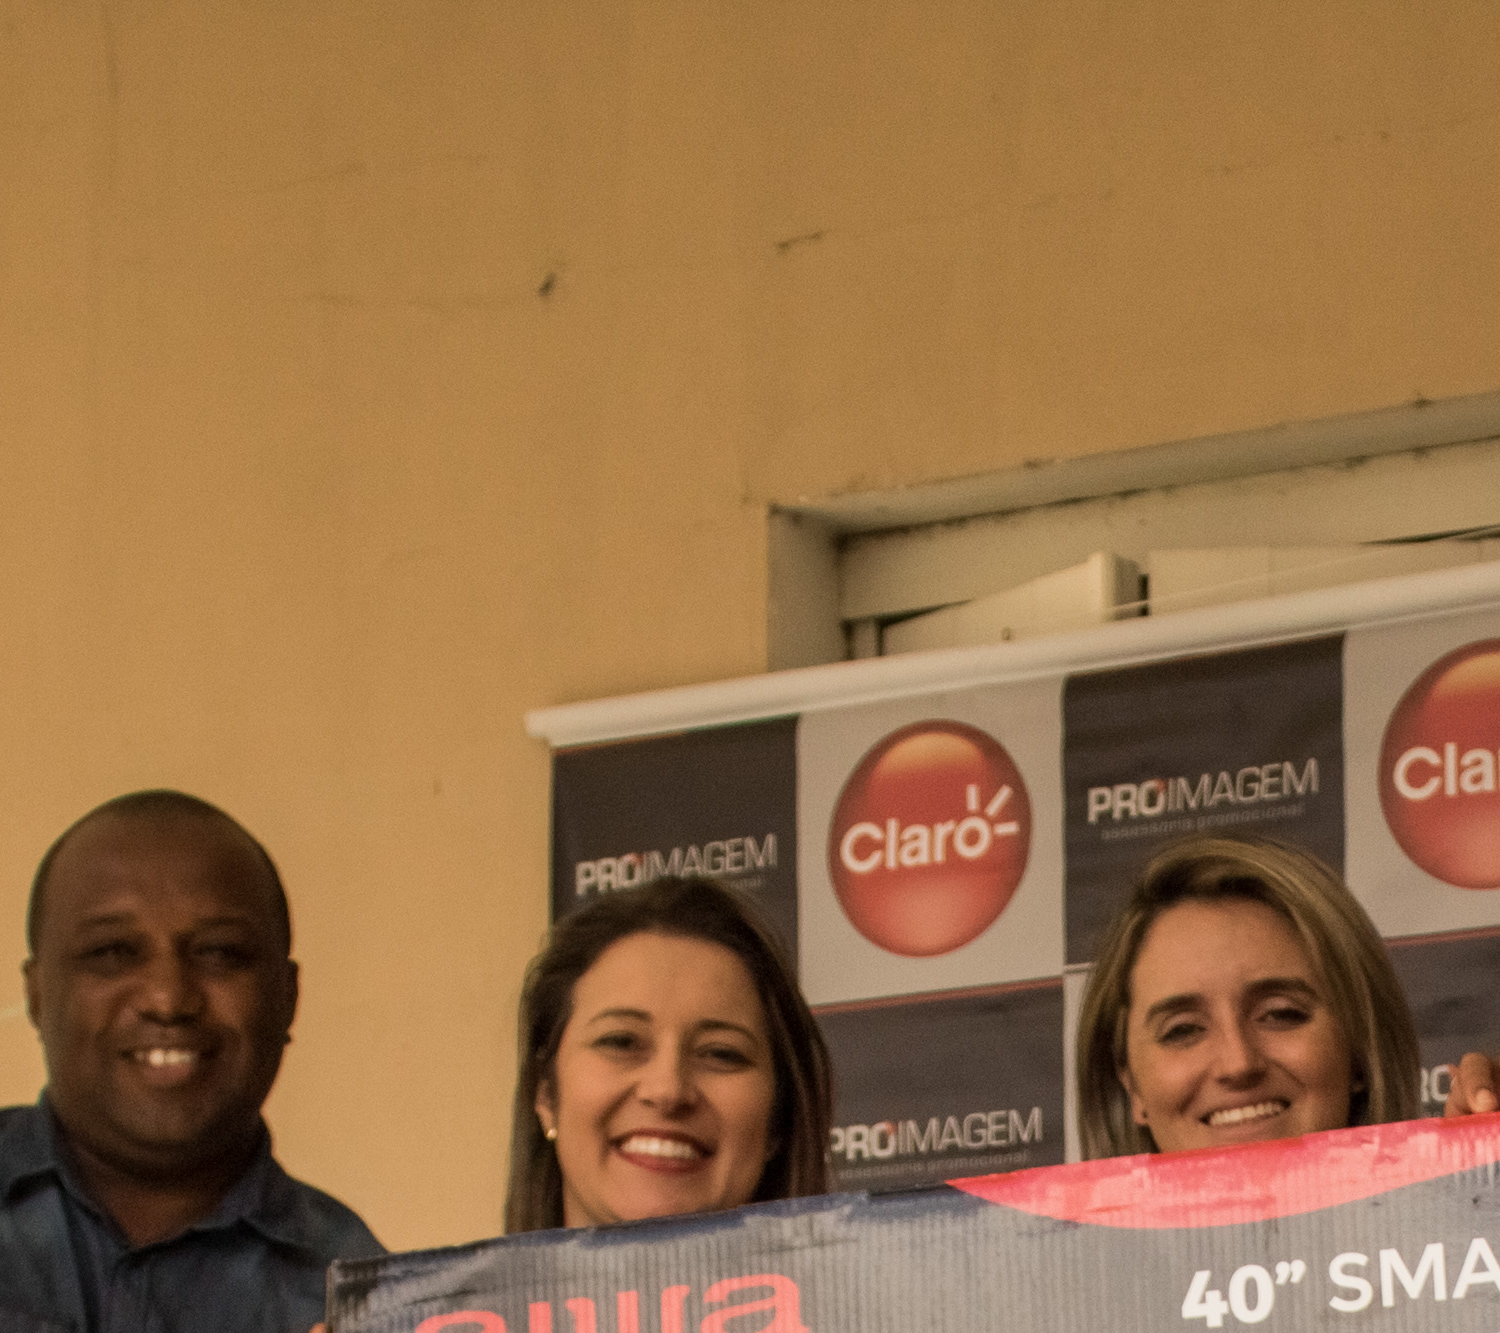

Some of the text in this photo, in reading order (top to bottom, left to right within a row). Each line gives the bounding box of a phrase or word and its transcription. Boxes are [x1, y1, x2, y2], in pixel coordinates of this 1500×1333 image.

[1087, 757, 1320, 825] PROIMAGEM
[575, 832, 779, 896] PROIMAGEM
[839, 808, 995, 876] Claro
